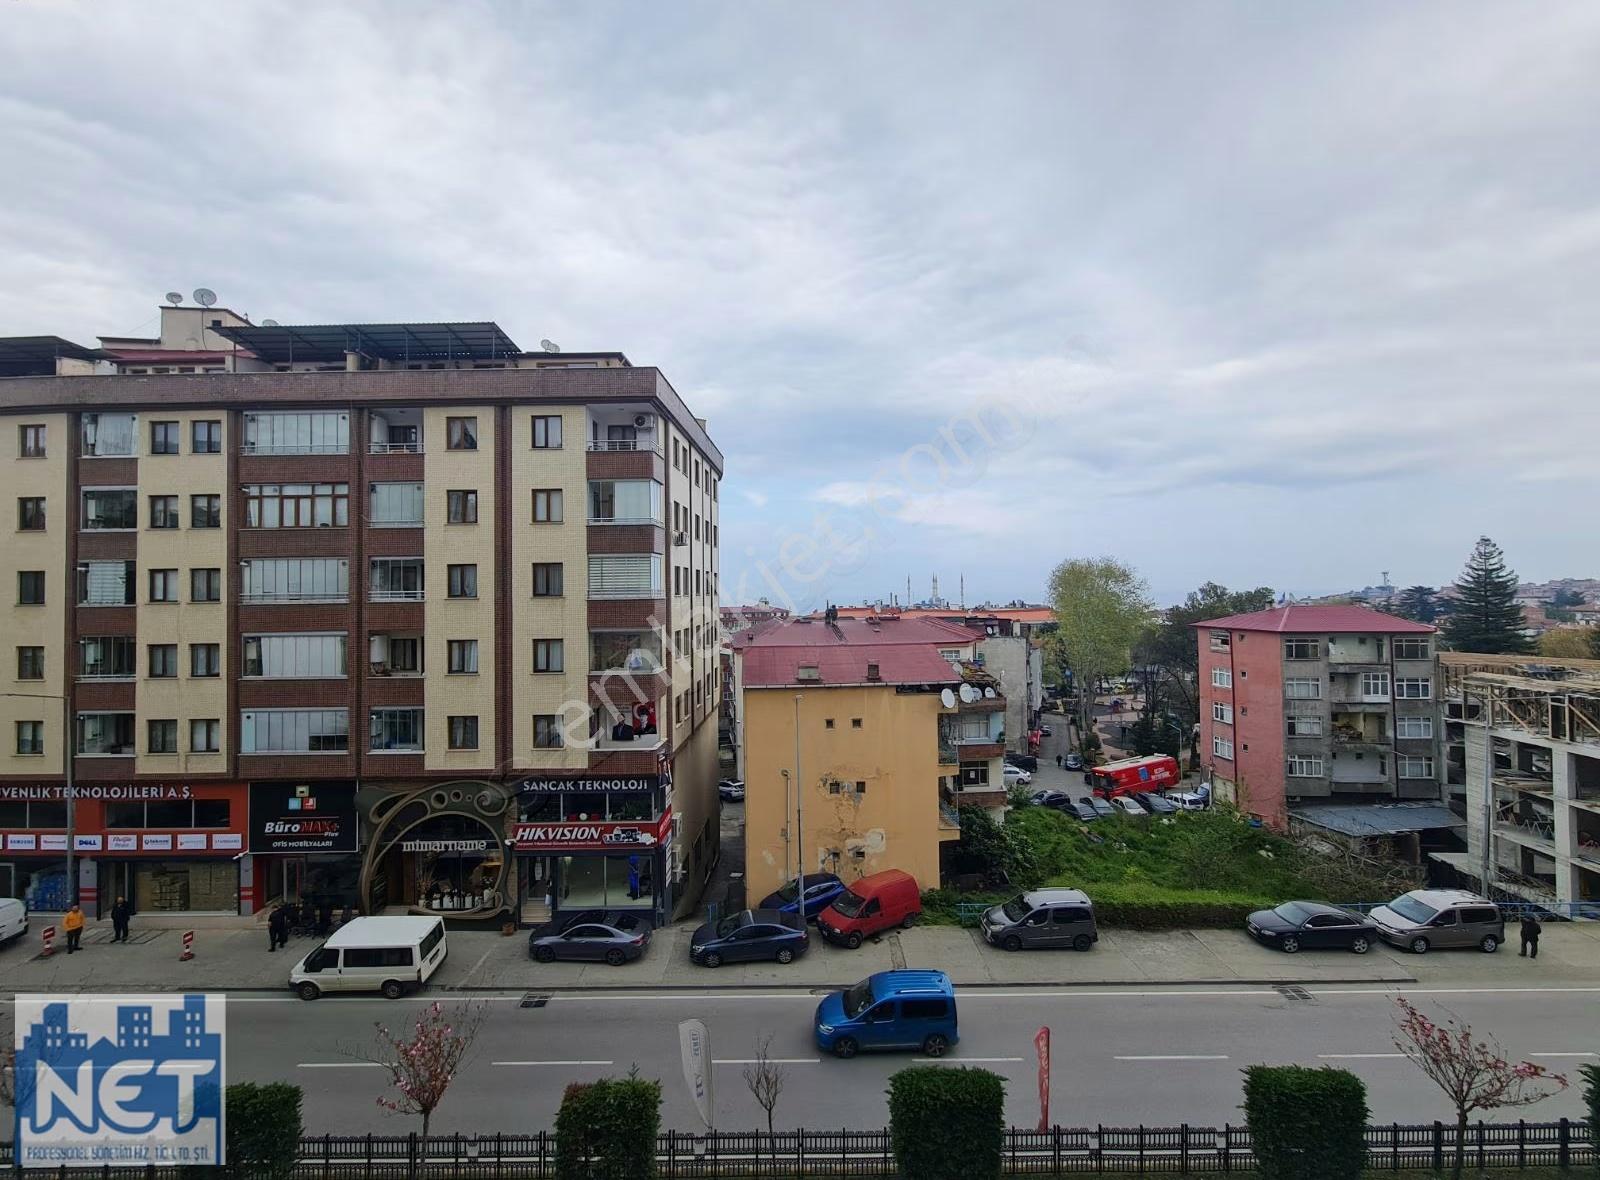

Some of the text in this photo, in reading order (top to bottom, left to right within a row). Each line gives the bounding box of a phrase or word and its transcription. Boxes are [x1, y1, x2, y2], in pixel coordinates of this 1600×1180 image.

[0, 784, 194, 799] VENLİK TEKNOLOJİLERİ A.Ş.
[523, 781, 575, 791] SANCAK
[516, 826, 602, 840] HIKVISION
[402, 840, 487, 852] mimarname
